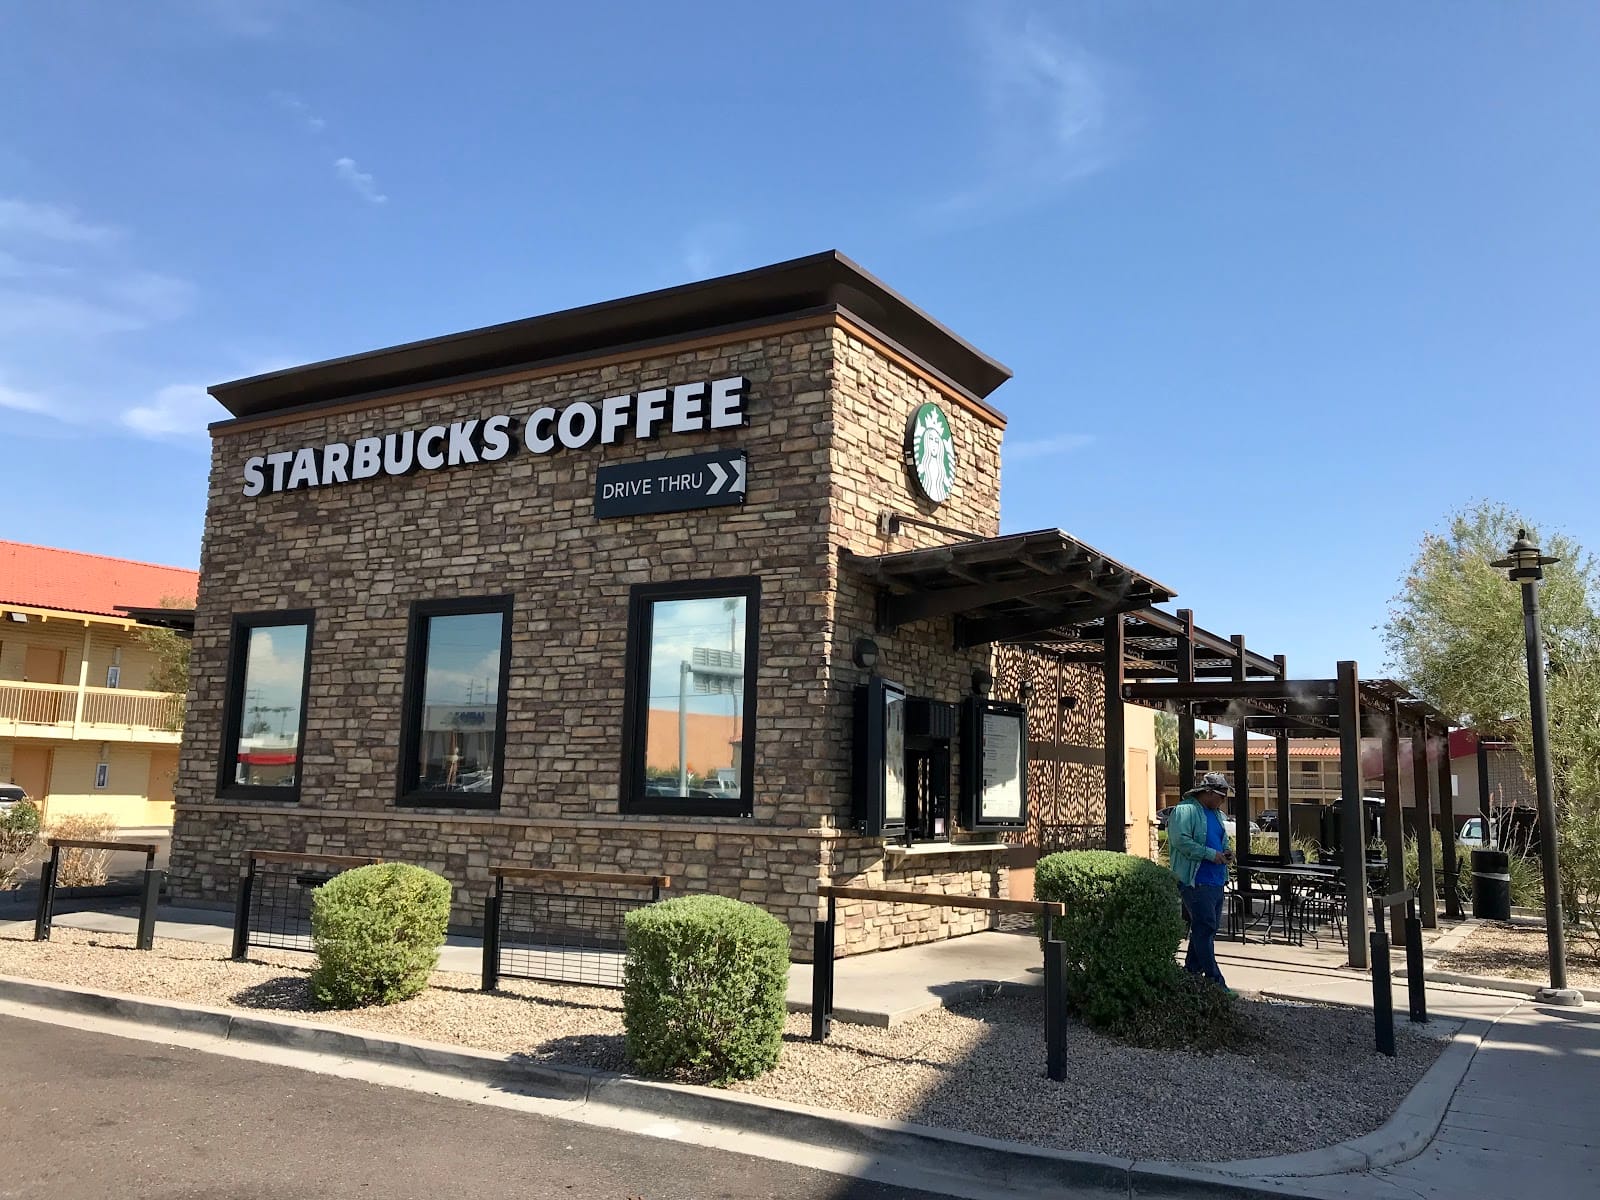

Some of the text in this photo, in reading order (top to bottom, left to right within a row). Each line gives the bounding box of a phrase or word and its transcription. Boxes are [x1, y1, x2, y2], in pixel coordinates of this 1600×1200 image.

[242, 376, 744, 497] STARBUCKS COFFEE
[602, 471, 703, 500] DRIVE THRU
